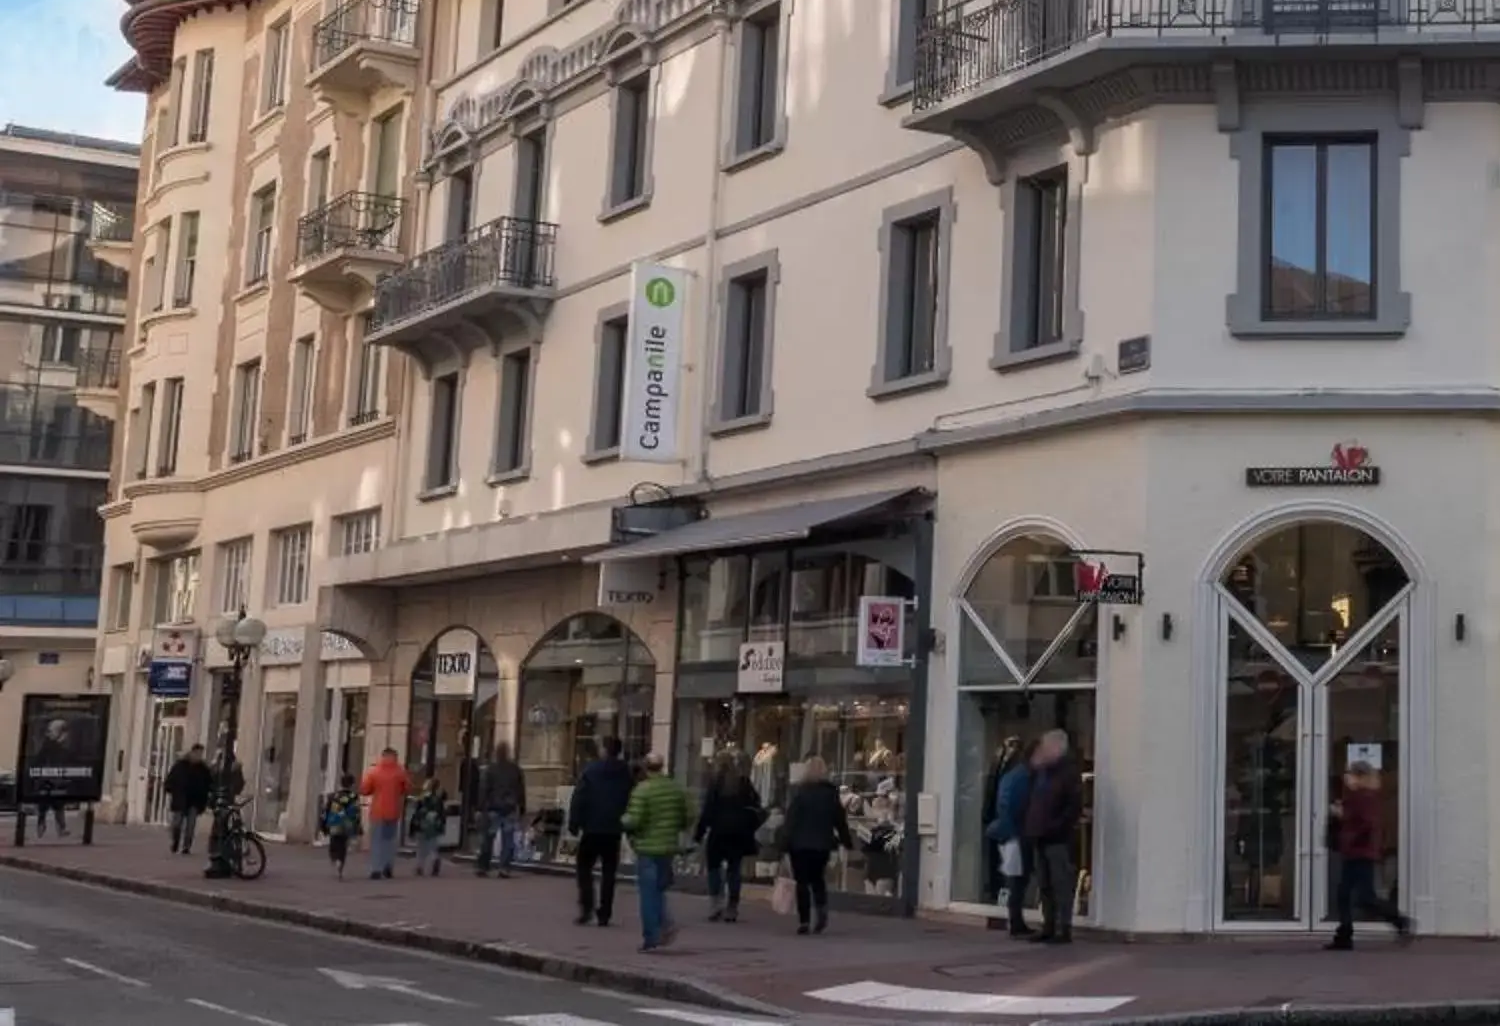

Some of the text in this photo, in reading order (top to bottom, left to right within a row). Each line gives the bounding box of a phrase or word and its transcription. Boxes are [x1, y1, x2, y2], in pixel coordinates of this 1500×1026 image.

[639, 325, 669, 451] Campanile
[1253, 469, 1373, 483] VOTRE PANTALON
[436, 652, 471, 675] TEXTO
